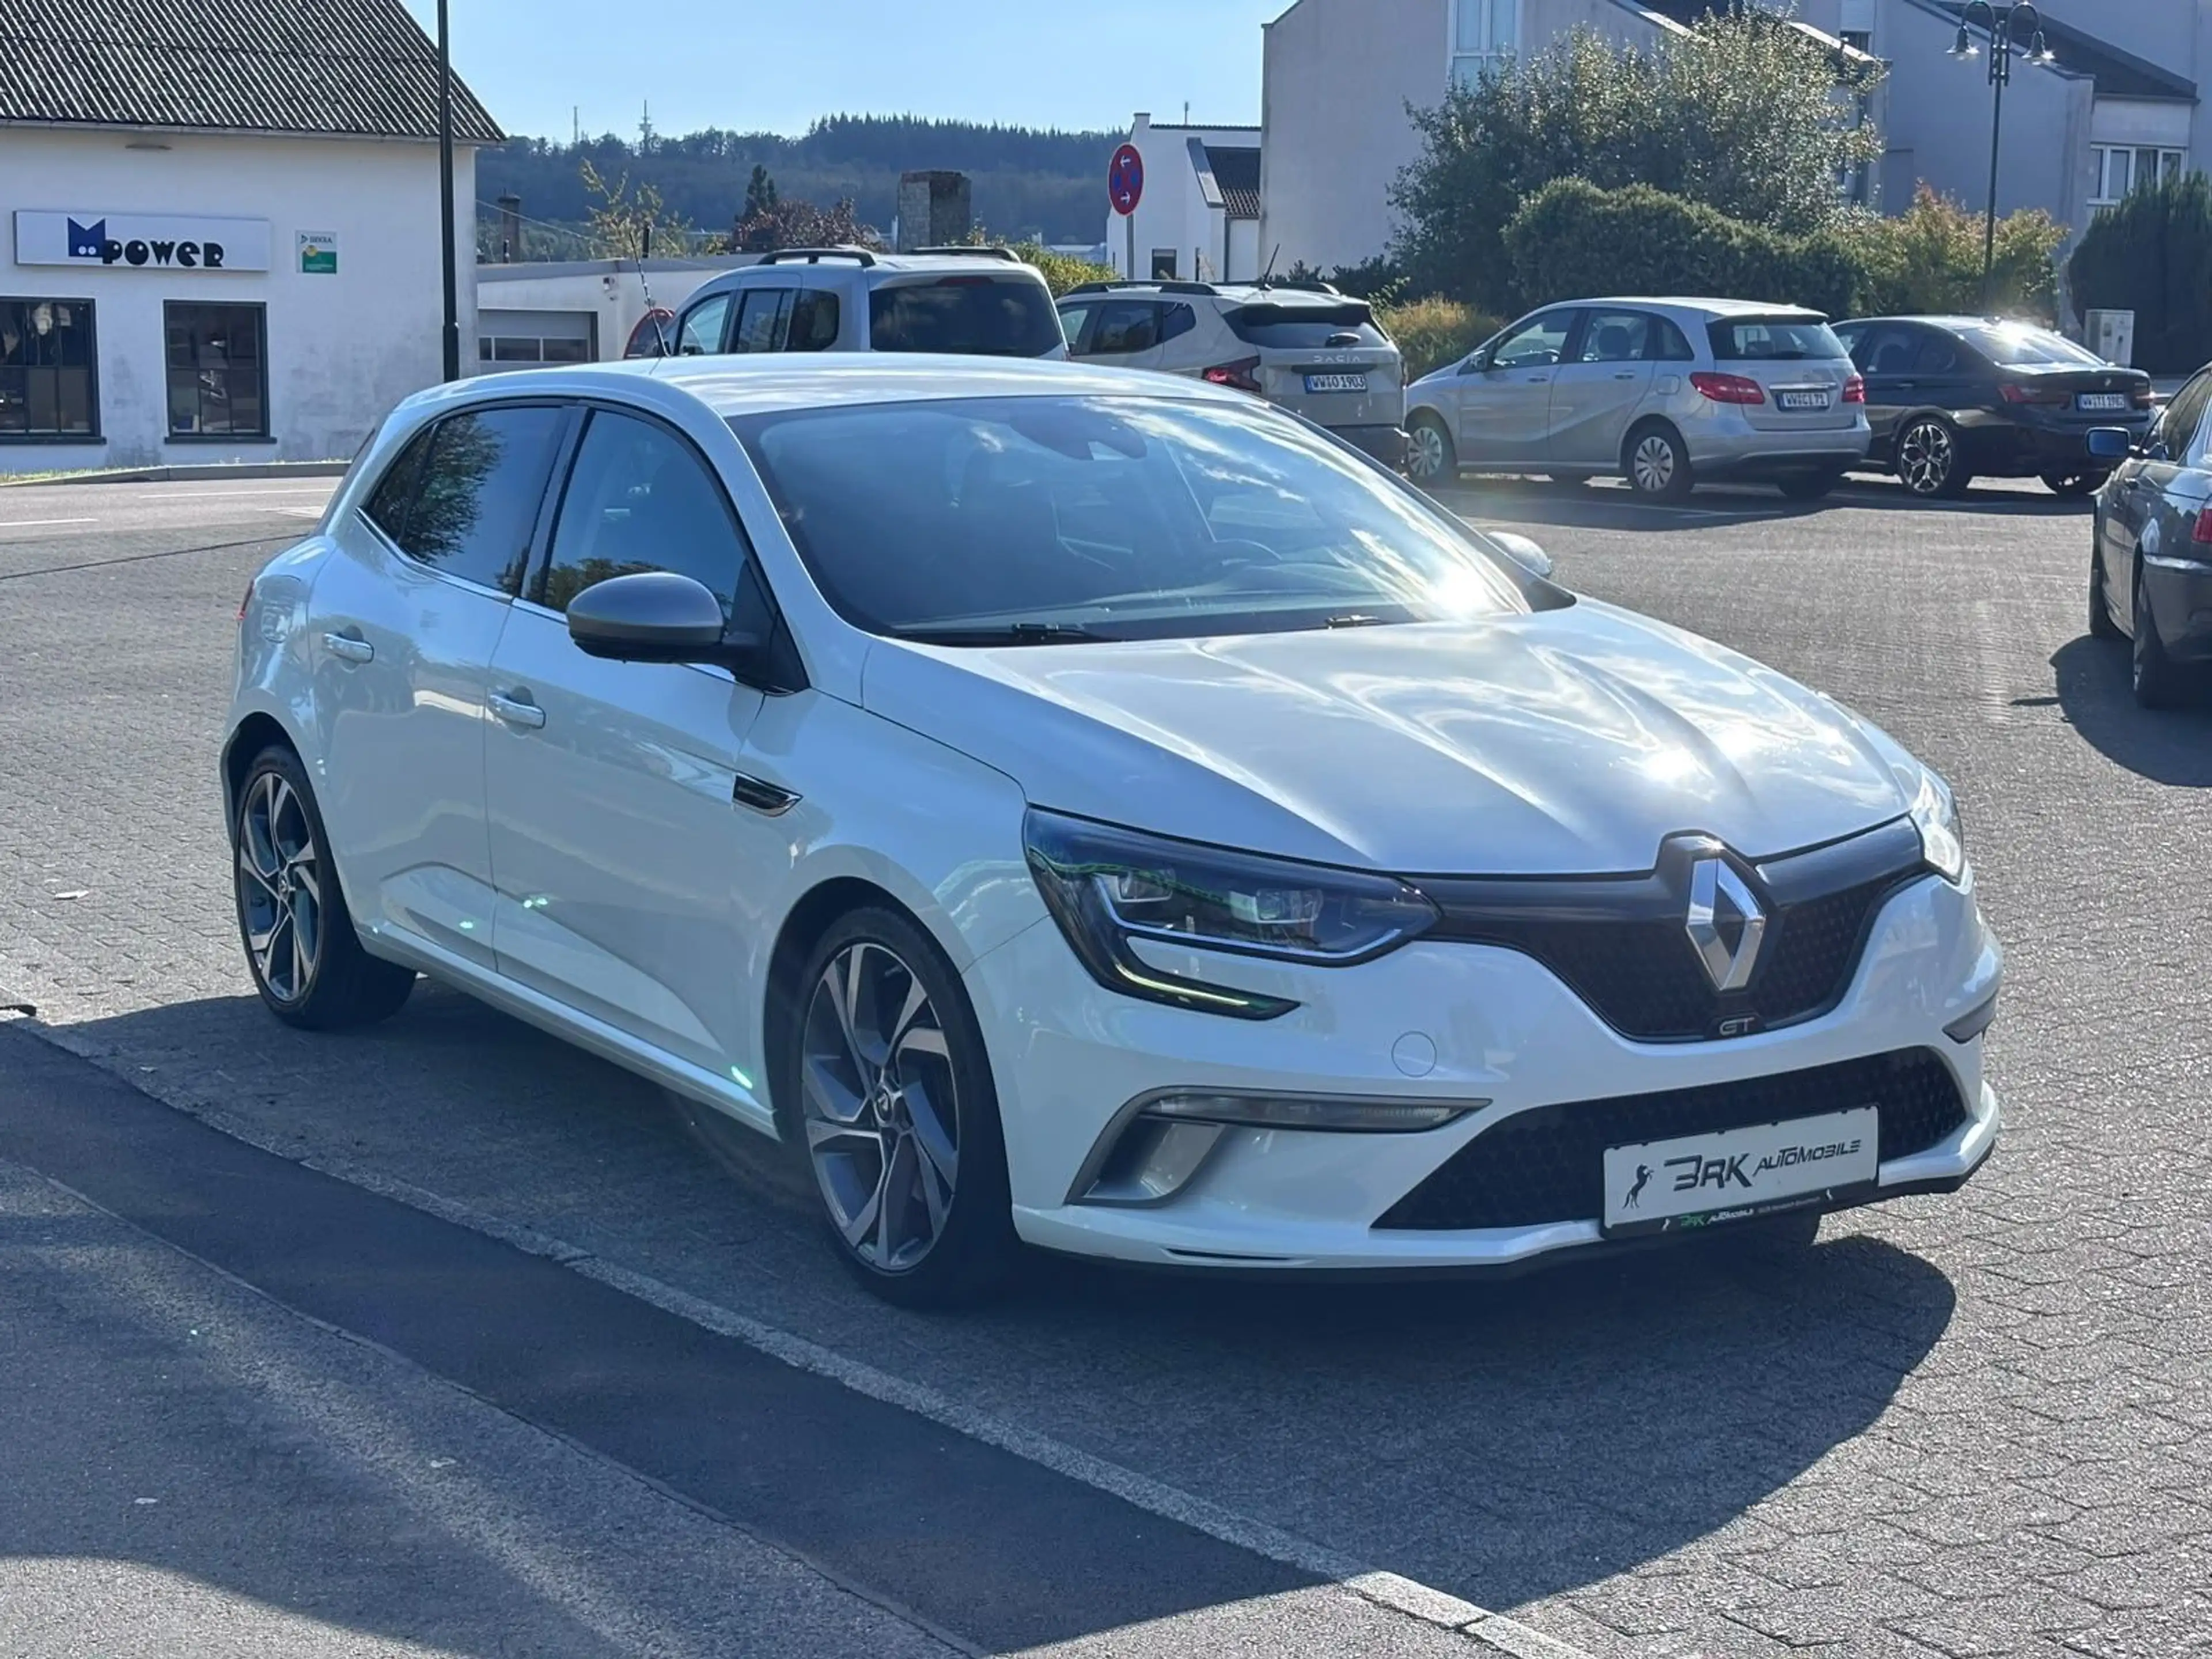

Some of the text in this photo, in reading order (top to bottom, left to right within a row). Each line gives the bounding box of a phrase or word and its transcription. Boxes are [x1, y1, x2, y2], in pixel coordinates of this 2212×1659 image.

[1313, 355, 1361, 365] DACIA
[1719, 1017, 1755, 1036] GT
[1753, 1139, 1862, 1176] AUTOMOBILE
